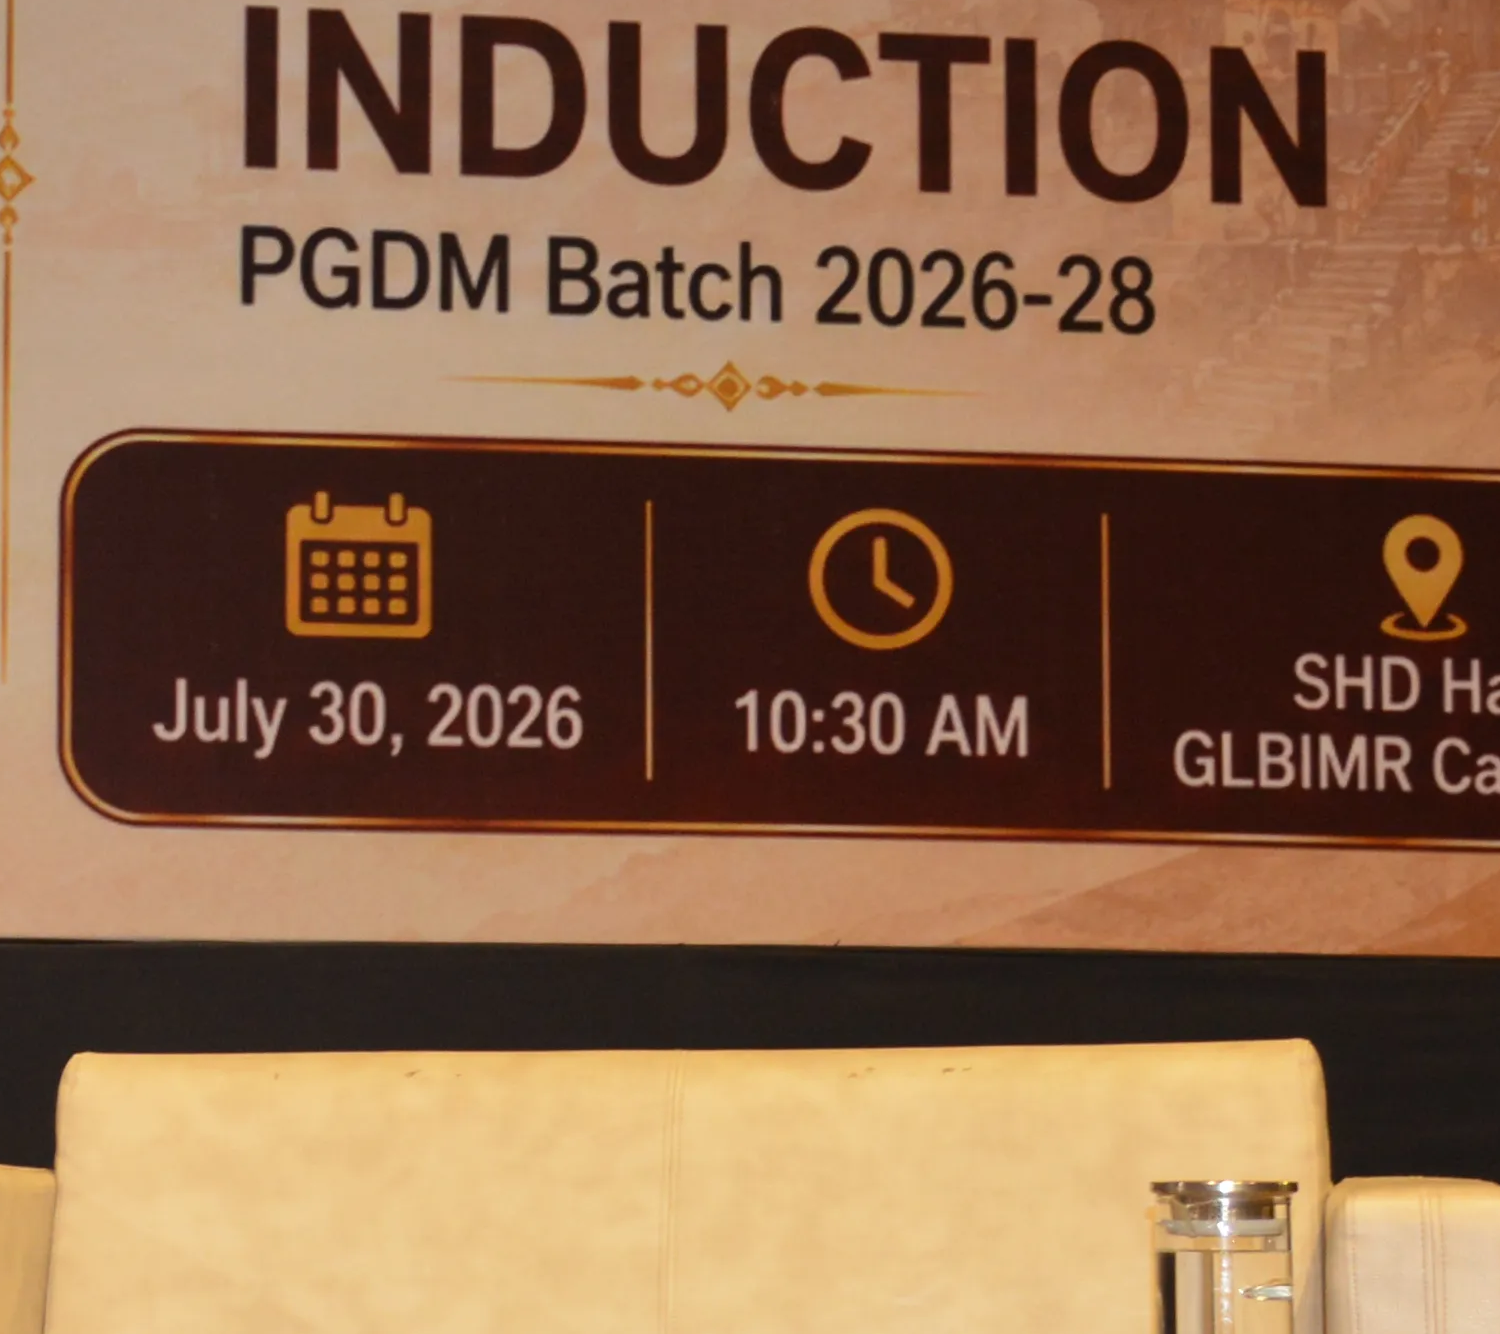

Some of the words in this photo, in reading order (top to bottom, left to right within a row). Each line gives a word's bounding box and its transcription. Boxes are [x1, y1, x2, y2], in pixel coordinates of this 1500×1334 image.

[242, 5, 1329, 208] INDUCTION
[240, 224, 510, 314] PGDM
[547, 235, 783, 322] Batch
[815, 245, 1157, 335] 2026-28
[152, 677, 287, 759] July
[308, 681, 403, 756] 30,
[428, 682, 582, 750] 2026
[1293, 652, 1421, 712] SHD
[735, 689, 905, 756] 10:30
[926, 693, 1028, 757] AM
[1173, 730, 1412, 792] GLBIMR
